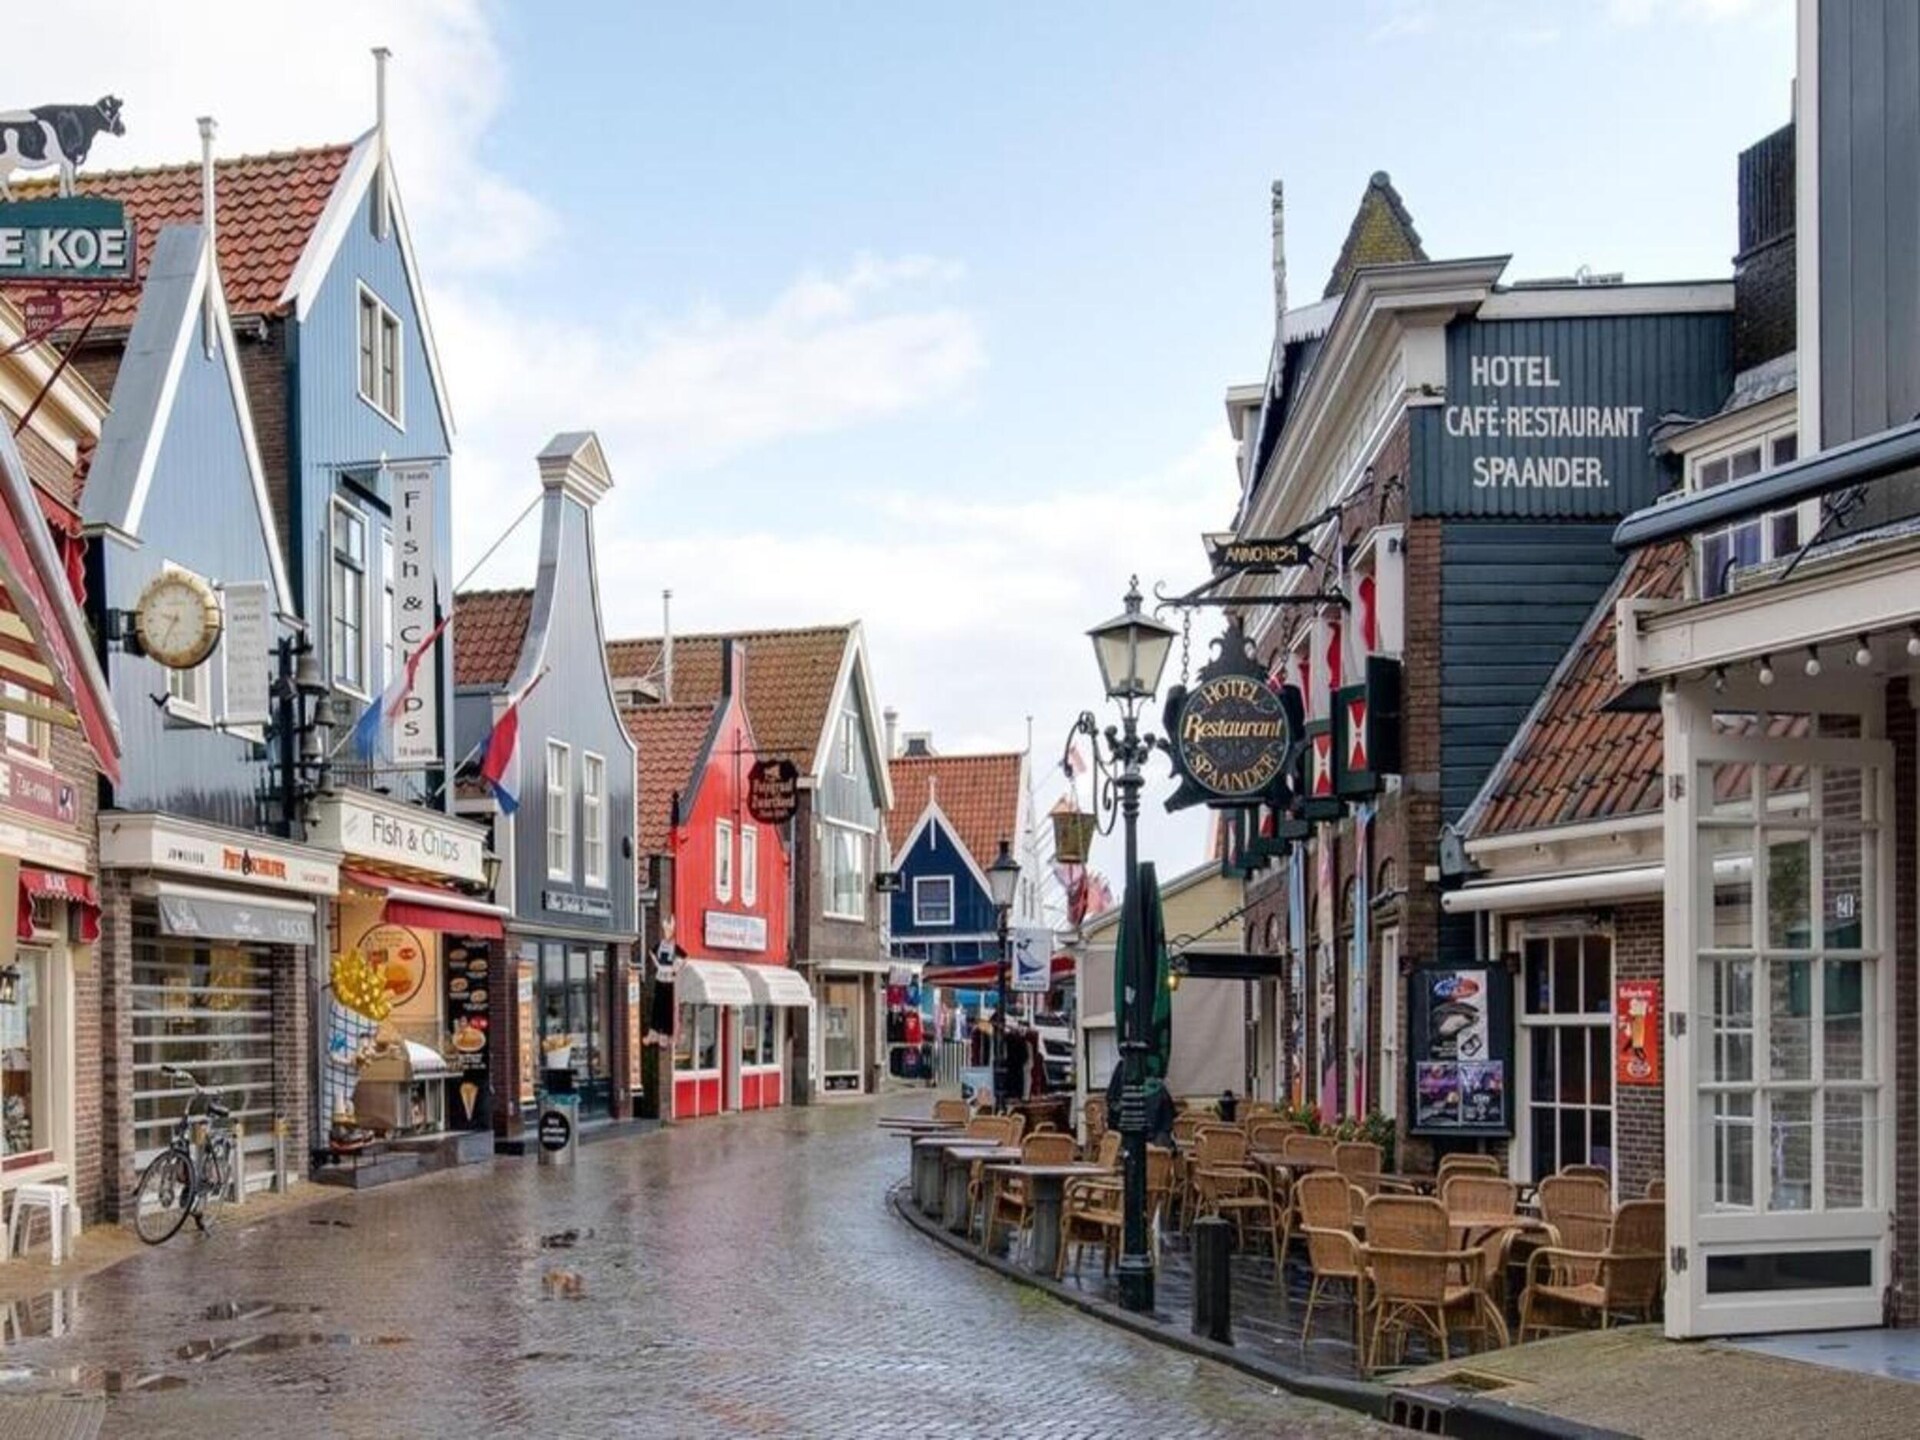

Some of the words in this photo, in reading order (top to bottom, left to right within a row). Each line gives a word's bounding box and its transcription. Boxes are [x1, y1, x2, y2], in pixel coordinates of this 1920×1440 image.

[38, 228, 126, 269] KOE
[1471, 355, 1560, 388] HOTEL
[1472, 456, 1610, 489] SPAANDER.
[402, 595, 423, 612] &
[1201, 679, 1260, 705] HOTEL
[1183, 713, 1284, 743] Restaurant
[1190, 753, 1278, 791] SPAANDER
[372, 813, 402, 849] Fish
[408, 829, 418, 851] &
[421, 826, 461, 862] Chips
